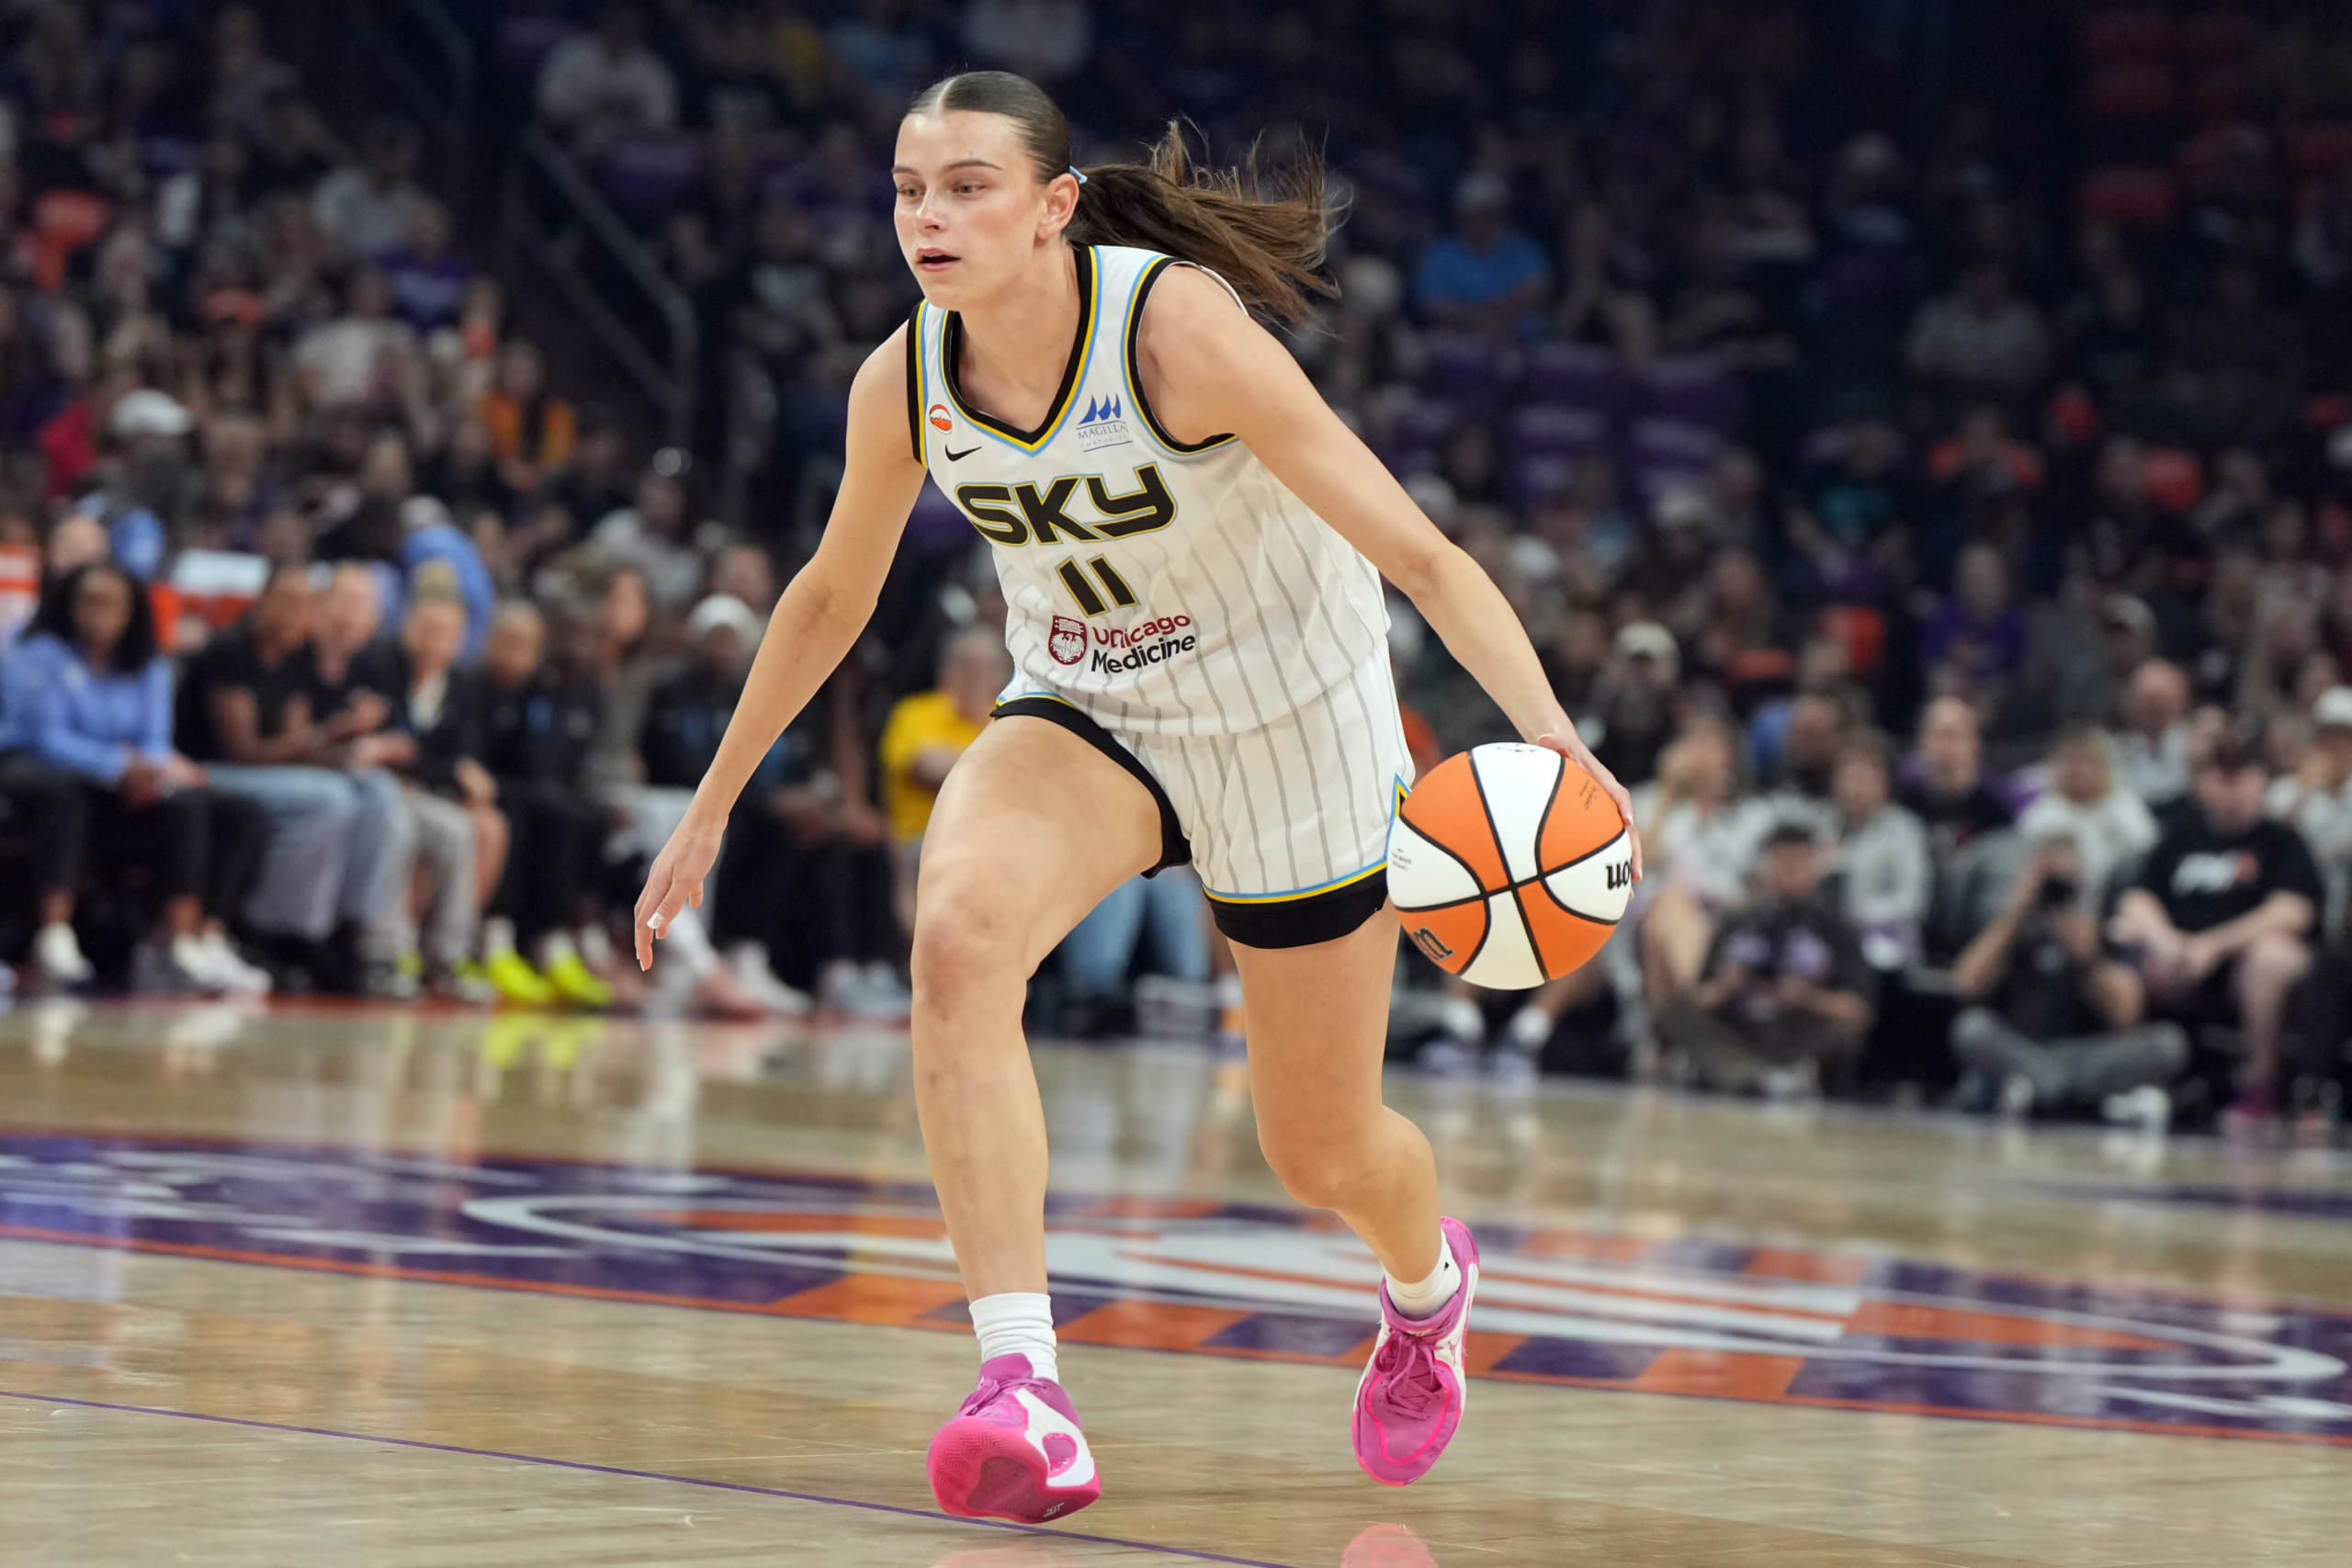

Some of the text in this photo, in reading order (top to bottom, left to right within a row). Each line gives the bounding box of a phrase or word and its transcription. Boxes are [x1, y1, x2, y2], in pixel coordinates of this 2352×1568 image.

[955, 461, 1178, 547] SKY
[1056, 554, 1139, 618] 11
[1091, 635, 1196, 674] Medicine
